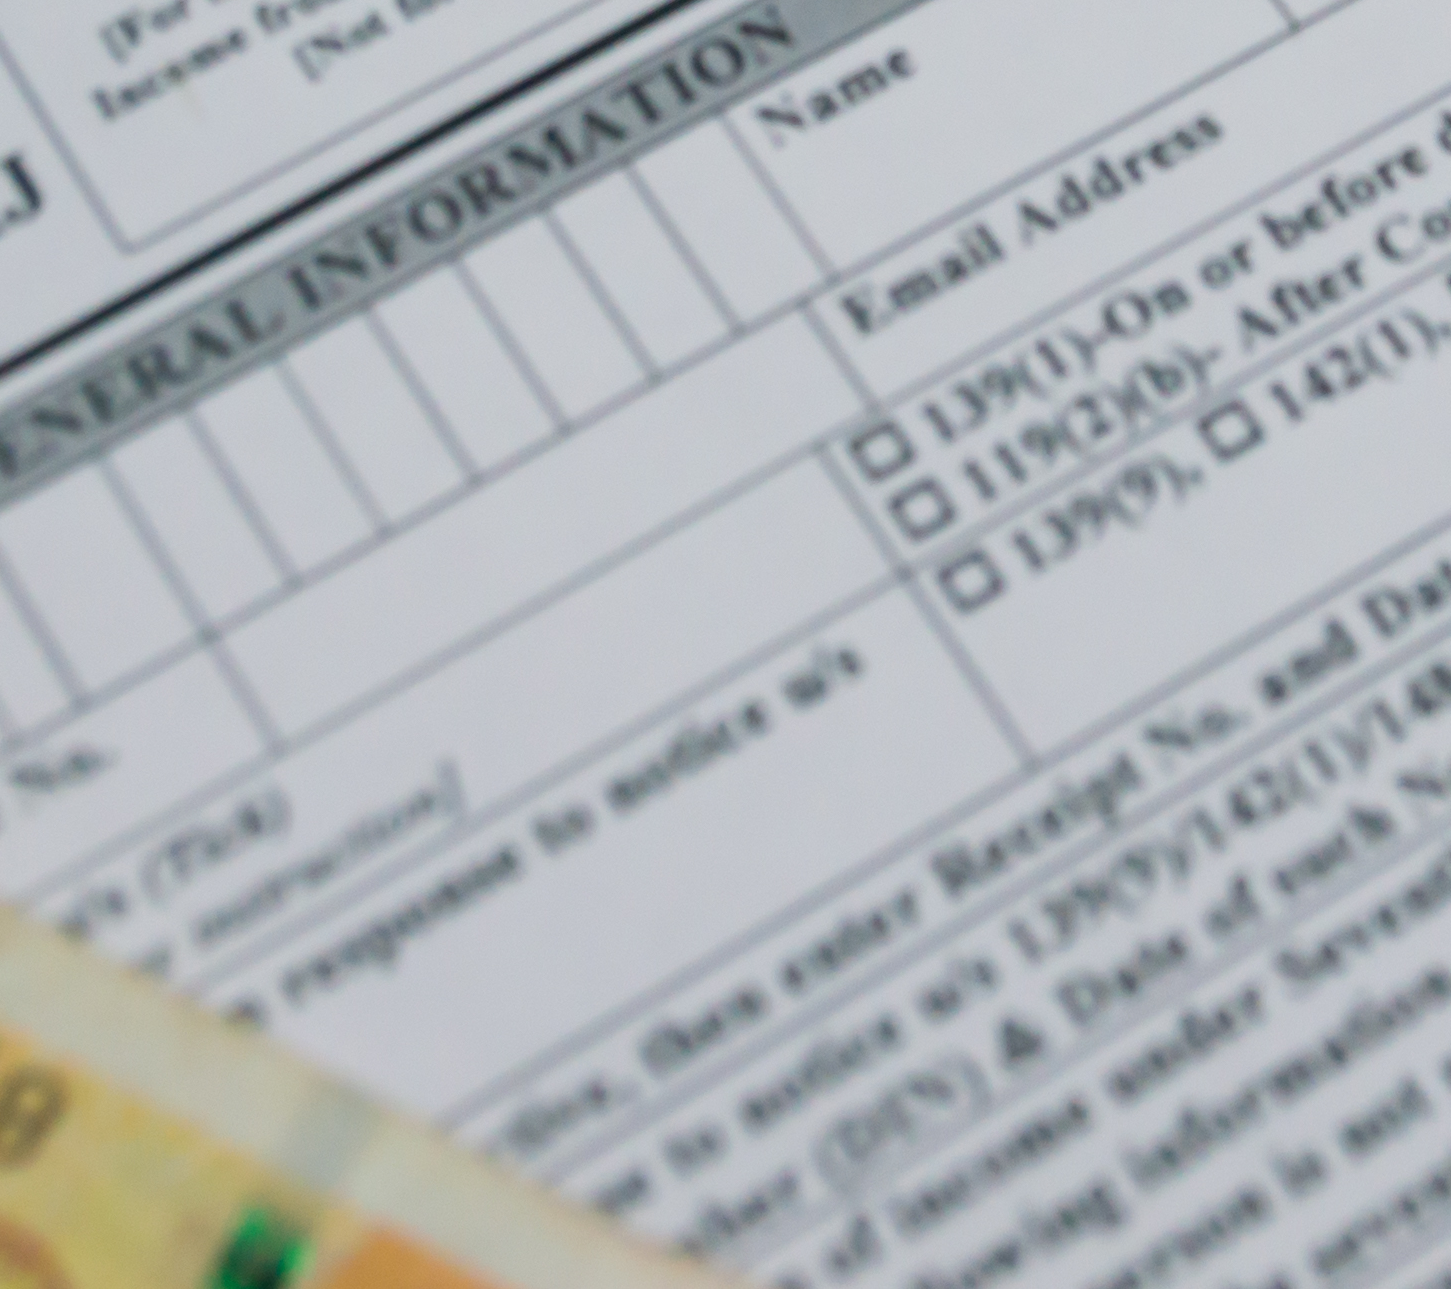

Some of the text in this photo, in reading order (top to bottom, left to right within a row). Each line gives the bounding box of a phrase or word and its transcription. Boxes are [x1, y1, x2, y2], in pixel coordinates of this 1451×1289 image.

[91, 27, 248, 120] Income
[291, 10, 389, 81] [Not
[752, 46, 916, 133] Name
[280, 0, 799, 315] INFORMATION
[835, 110, 1226, 338] Email Address
[919, 276, 1194, 445] 139(1)-On
[1195, 237, 1255, 292] or
[1253, 142, 1431, 254] before
[958, 343, 1224, 505] 119(2)(b)-
[1233, 251, 1367, 352] After
[1007, 452, 1207, 576] 139(9),
